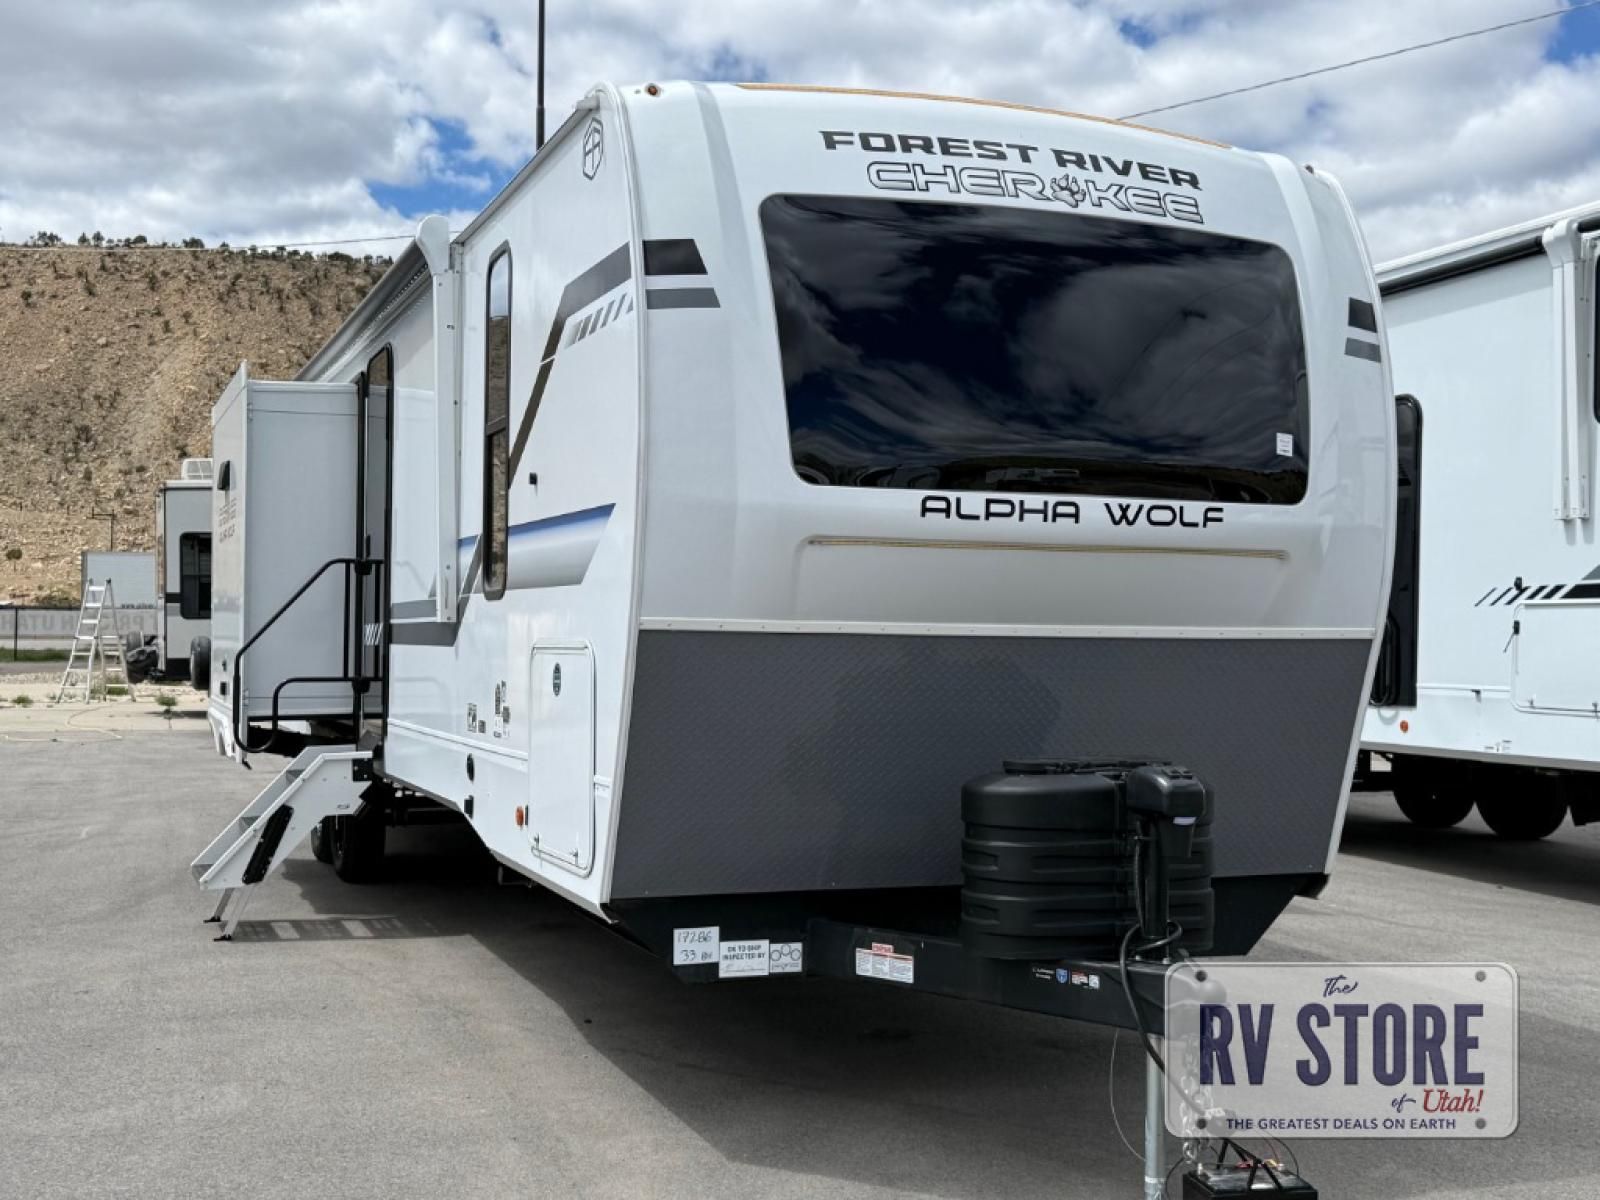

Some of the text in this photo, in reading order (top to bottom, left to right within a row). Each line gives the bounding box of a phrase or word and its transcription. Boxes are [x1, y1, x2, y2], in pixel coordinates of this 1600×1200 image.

[818, 130, 1202, 190] FOREST RIVER
[920, 495, 1224, 528] ALPHA WOLF
